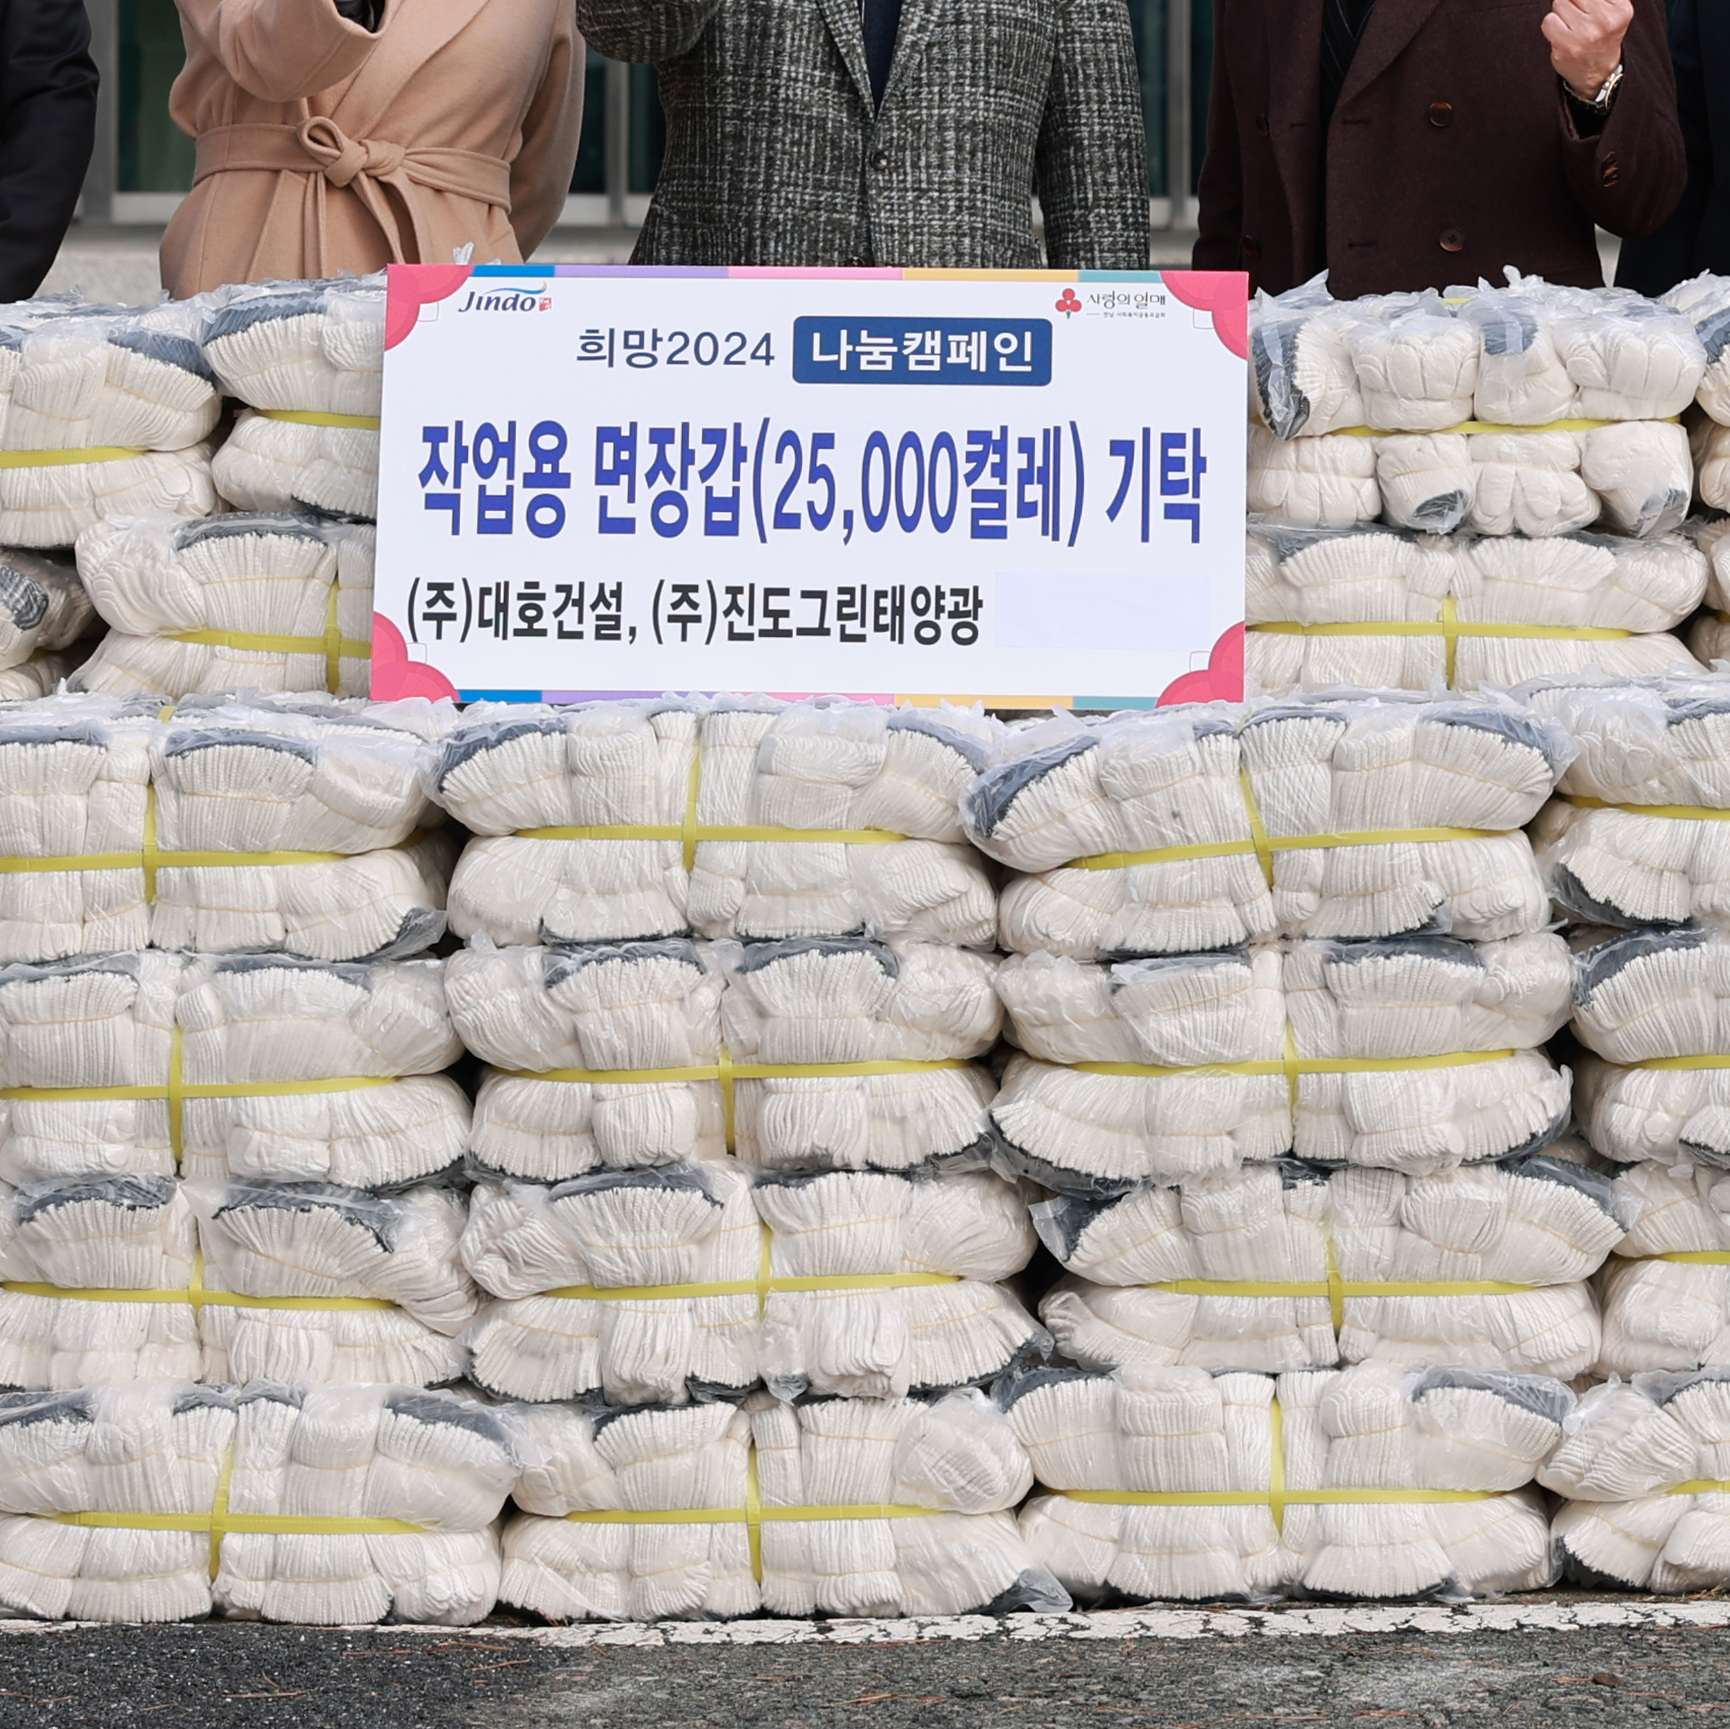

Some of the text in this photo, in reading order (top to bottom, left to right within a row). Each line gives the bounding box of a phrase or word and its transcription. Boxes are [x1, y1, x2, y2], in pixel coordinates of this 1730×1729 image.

[458, 291, 536, 312] Jindo
[1086, 290, 1131, 310] 사랑의
[575, 326, 1033, 374] 희망2024 나눔캠페인
[417, 417, 1207, 548] 작업용 면장갑(25,000켤레) 기탁
[407, 577, 984, 647] (주)대호건설, (주)진도그린태양광
